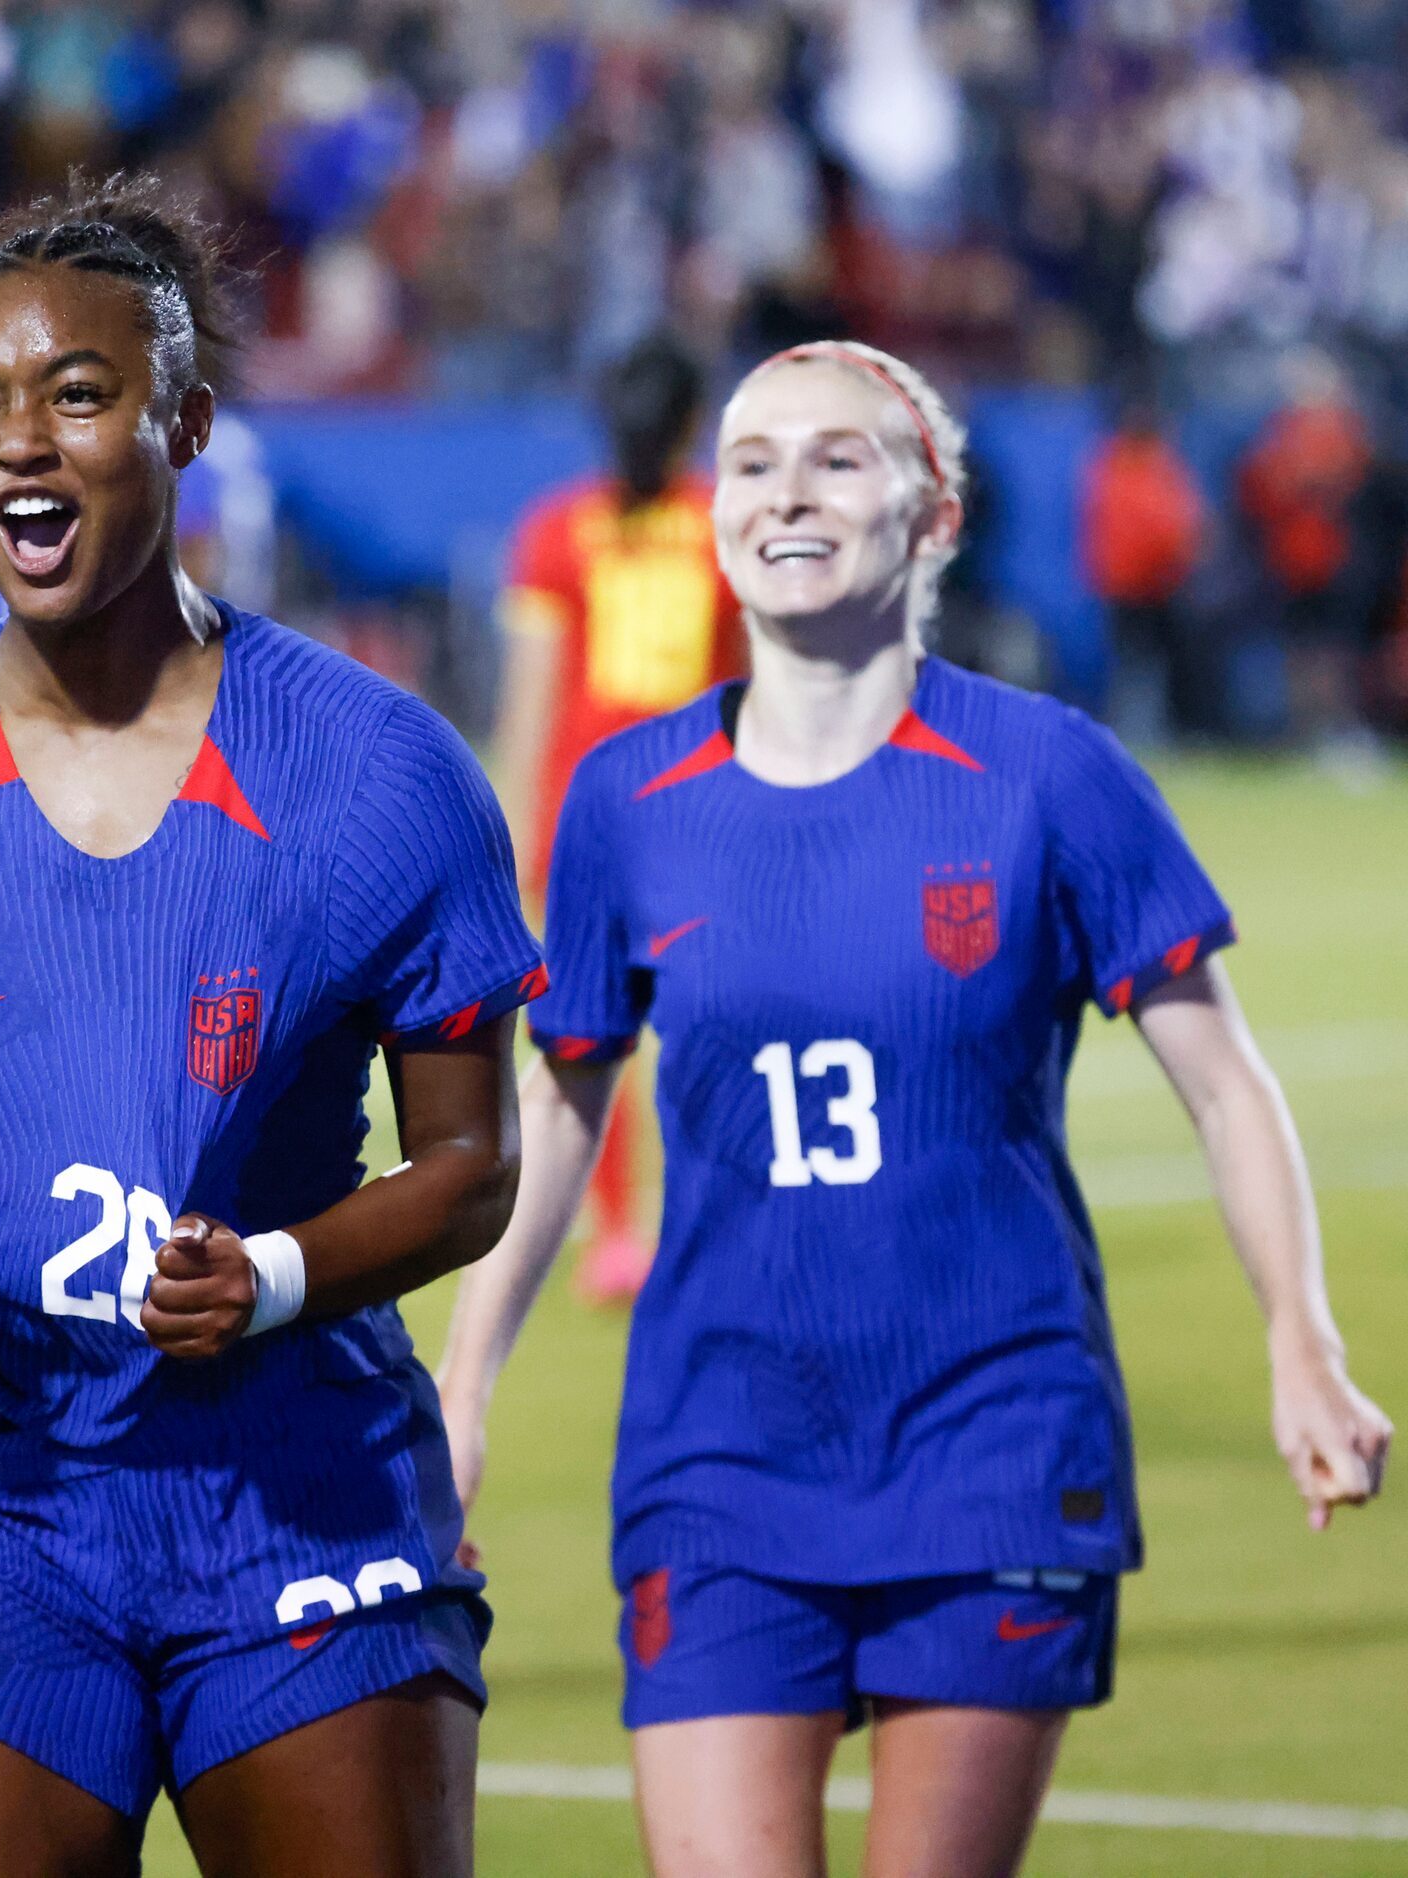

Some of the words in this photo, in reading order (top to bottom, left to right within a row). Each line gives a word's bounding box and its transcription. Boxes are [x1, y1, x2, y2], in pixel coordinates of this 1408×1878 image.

[926, 884, 991, 920] USA
[195, 995, 254, 1035] USA
[752, 1037, 883, 1188] 13
